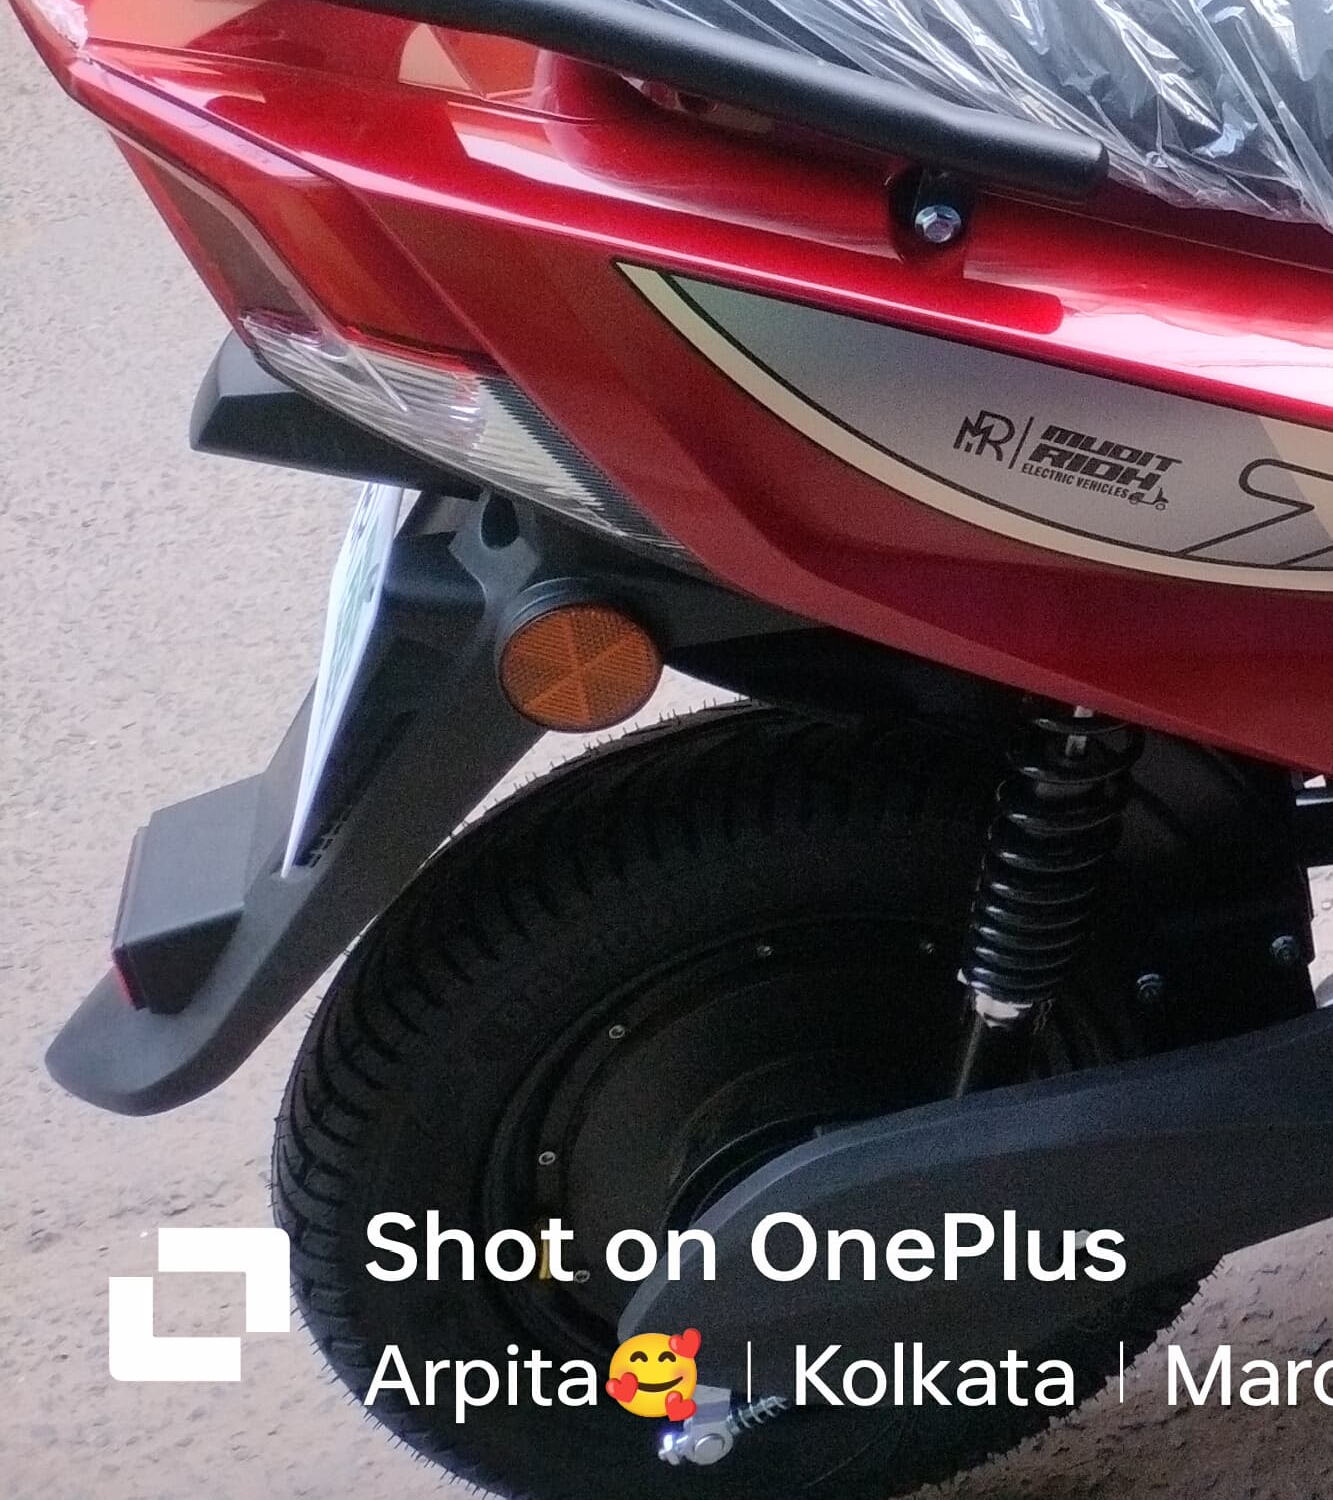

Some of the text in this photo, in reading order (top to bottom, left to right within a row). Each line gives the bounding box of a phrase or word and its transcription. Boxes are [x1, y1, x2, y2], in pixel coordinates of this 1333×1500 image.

[1040, 424, 1183, 472] MUDIT
[1021, 462, 1131, 499] ELECTRIC VEHICLES
